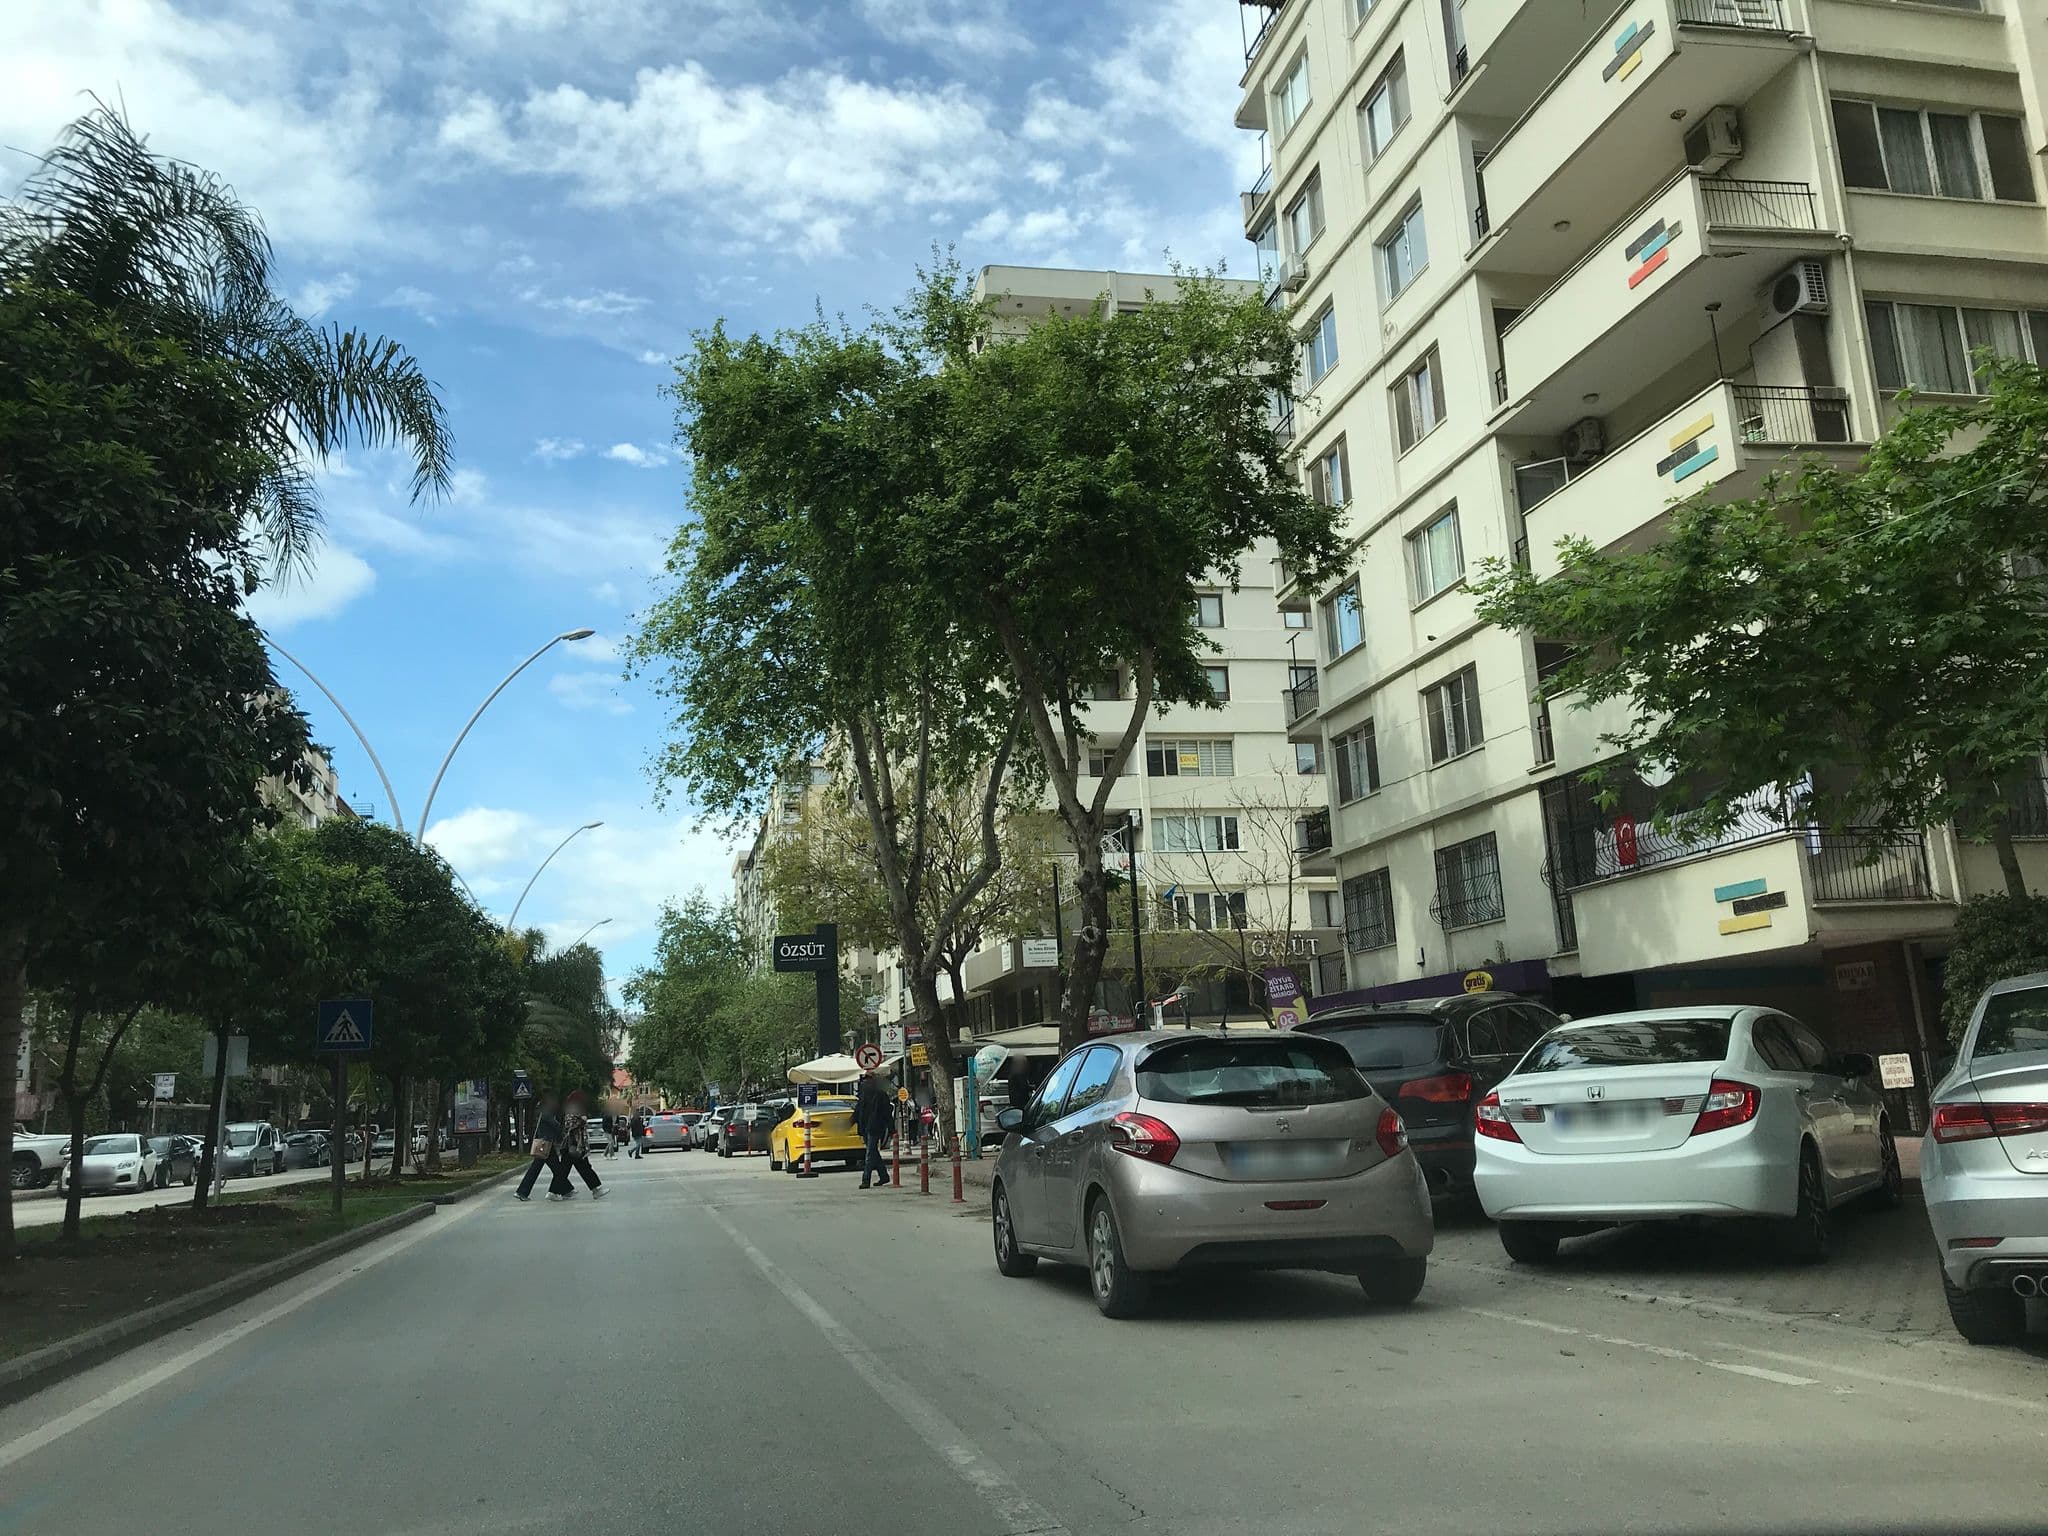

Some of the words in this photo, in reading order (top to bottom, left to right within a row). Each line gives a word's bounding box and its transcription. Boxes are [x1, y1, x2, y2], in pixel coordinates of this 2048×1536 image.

[780, 942, 826, 957] ÖZSÜT
[1252, 934, 1319, 957] ÖÜT
[1466, 975, 1485, 991] gratis
[804, 1095, 811, 1104] P
